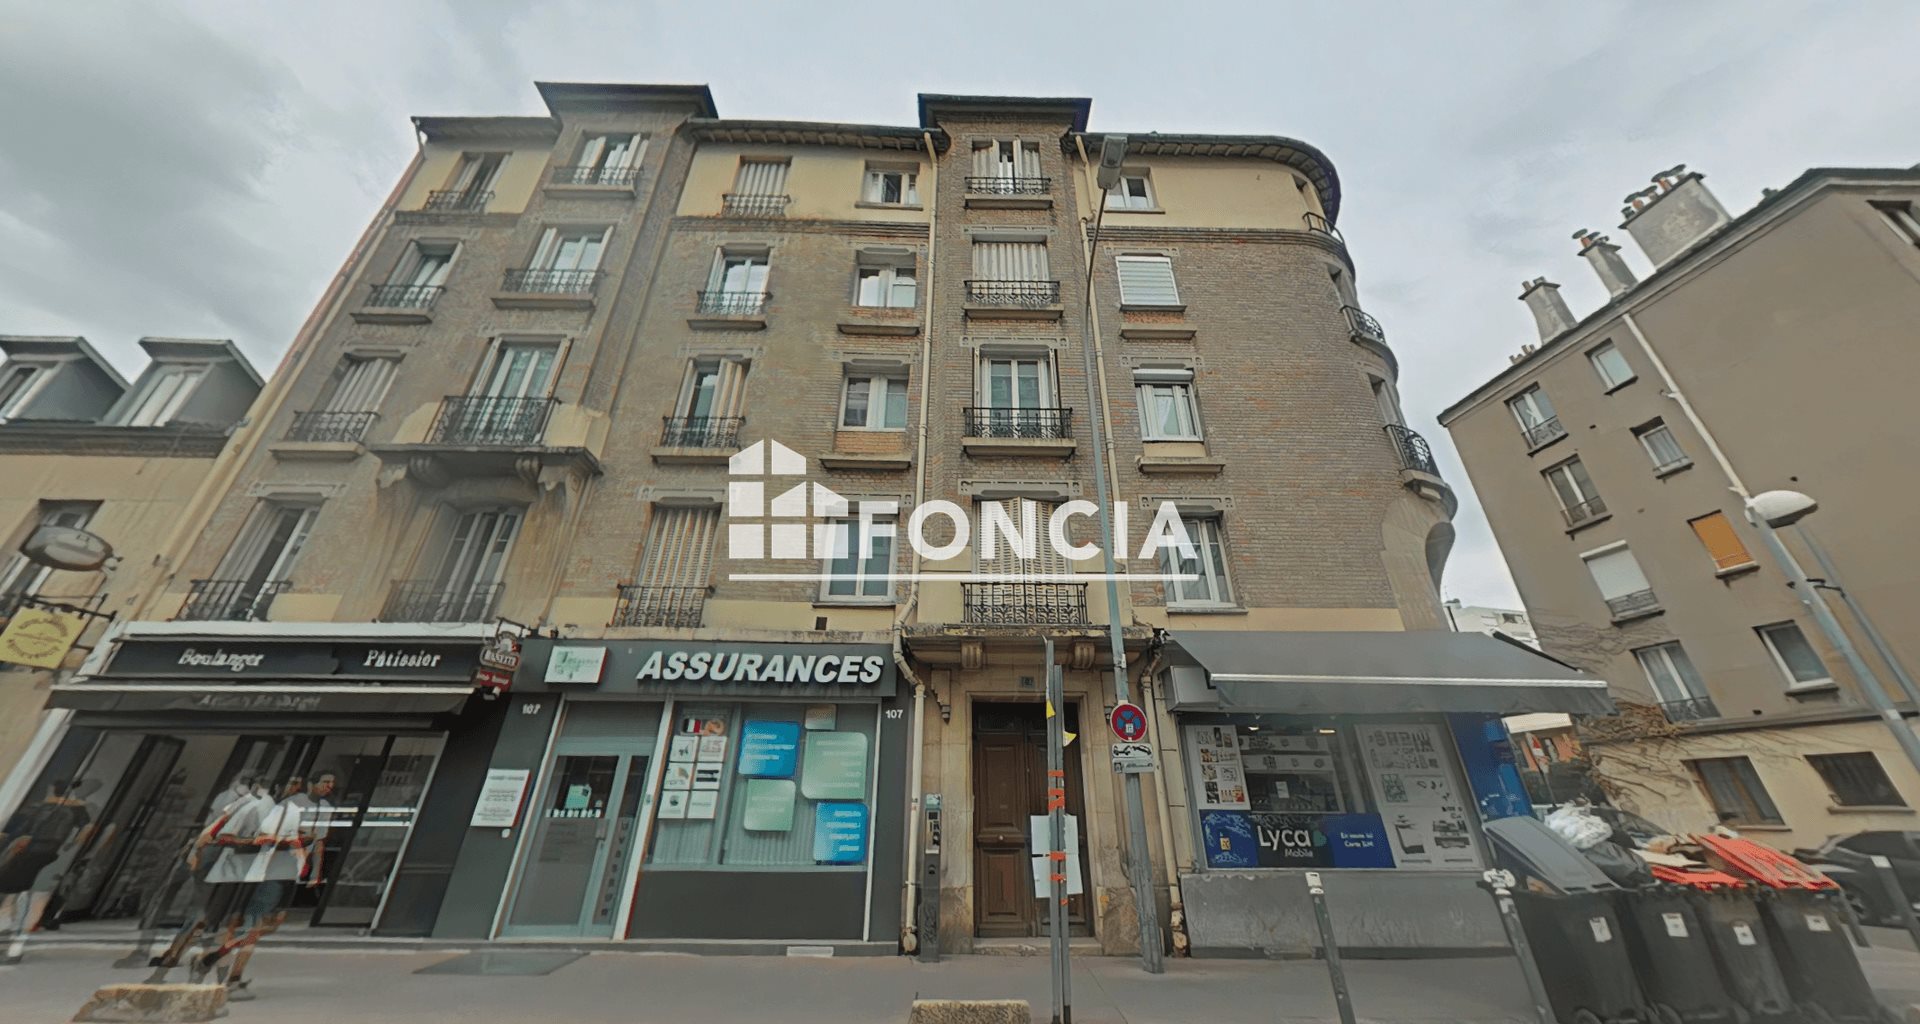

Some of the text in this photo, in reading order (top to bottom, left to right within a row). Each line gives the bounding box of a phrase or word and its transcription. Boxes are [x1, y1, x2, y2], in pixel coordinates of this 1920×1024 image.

[636, 651, 884, 683] ASSURANCES
[522, 704, 541, 715] 107
[885, 709, 904, 719] 107
[1257, 825, 1312, 851] Lyca
